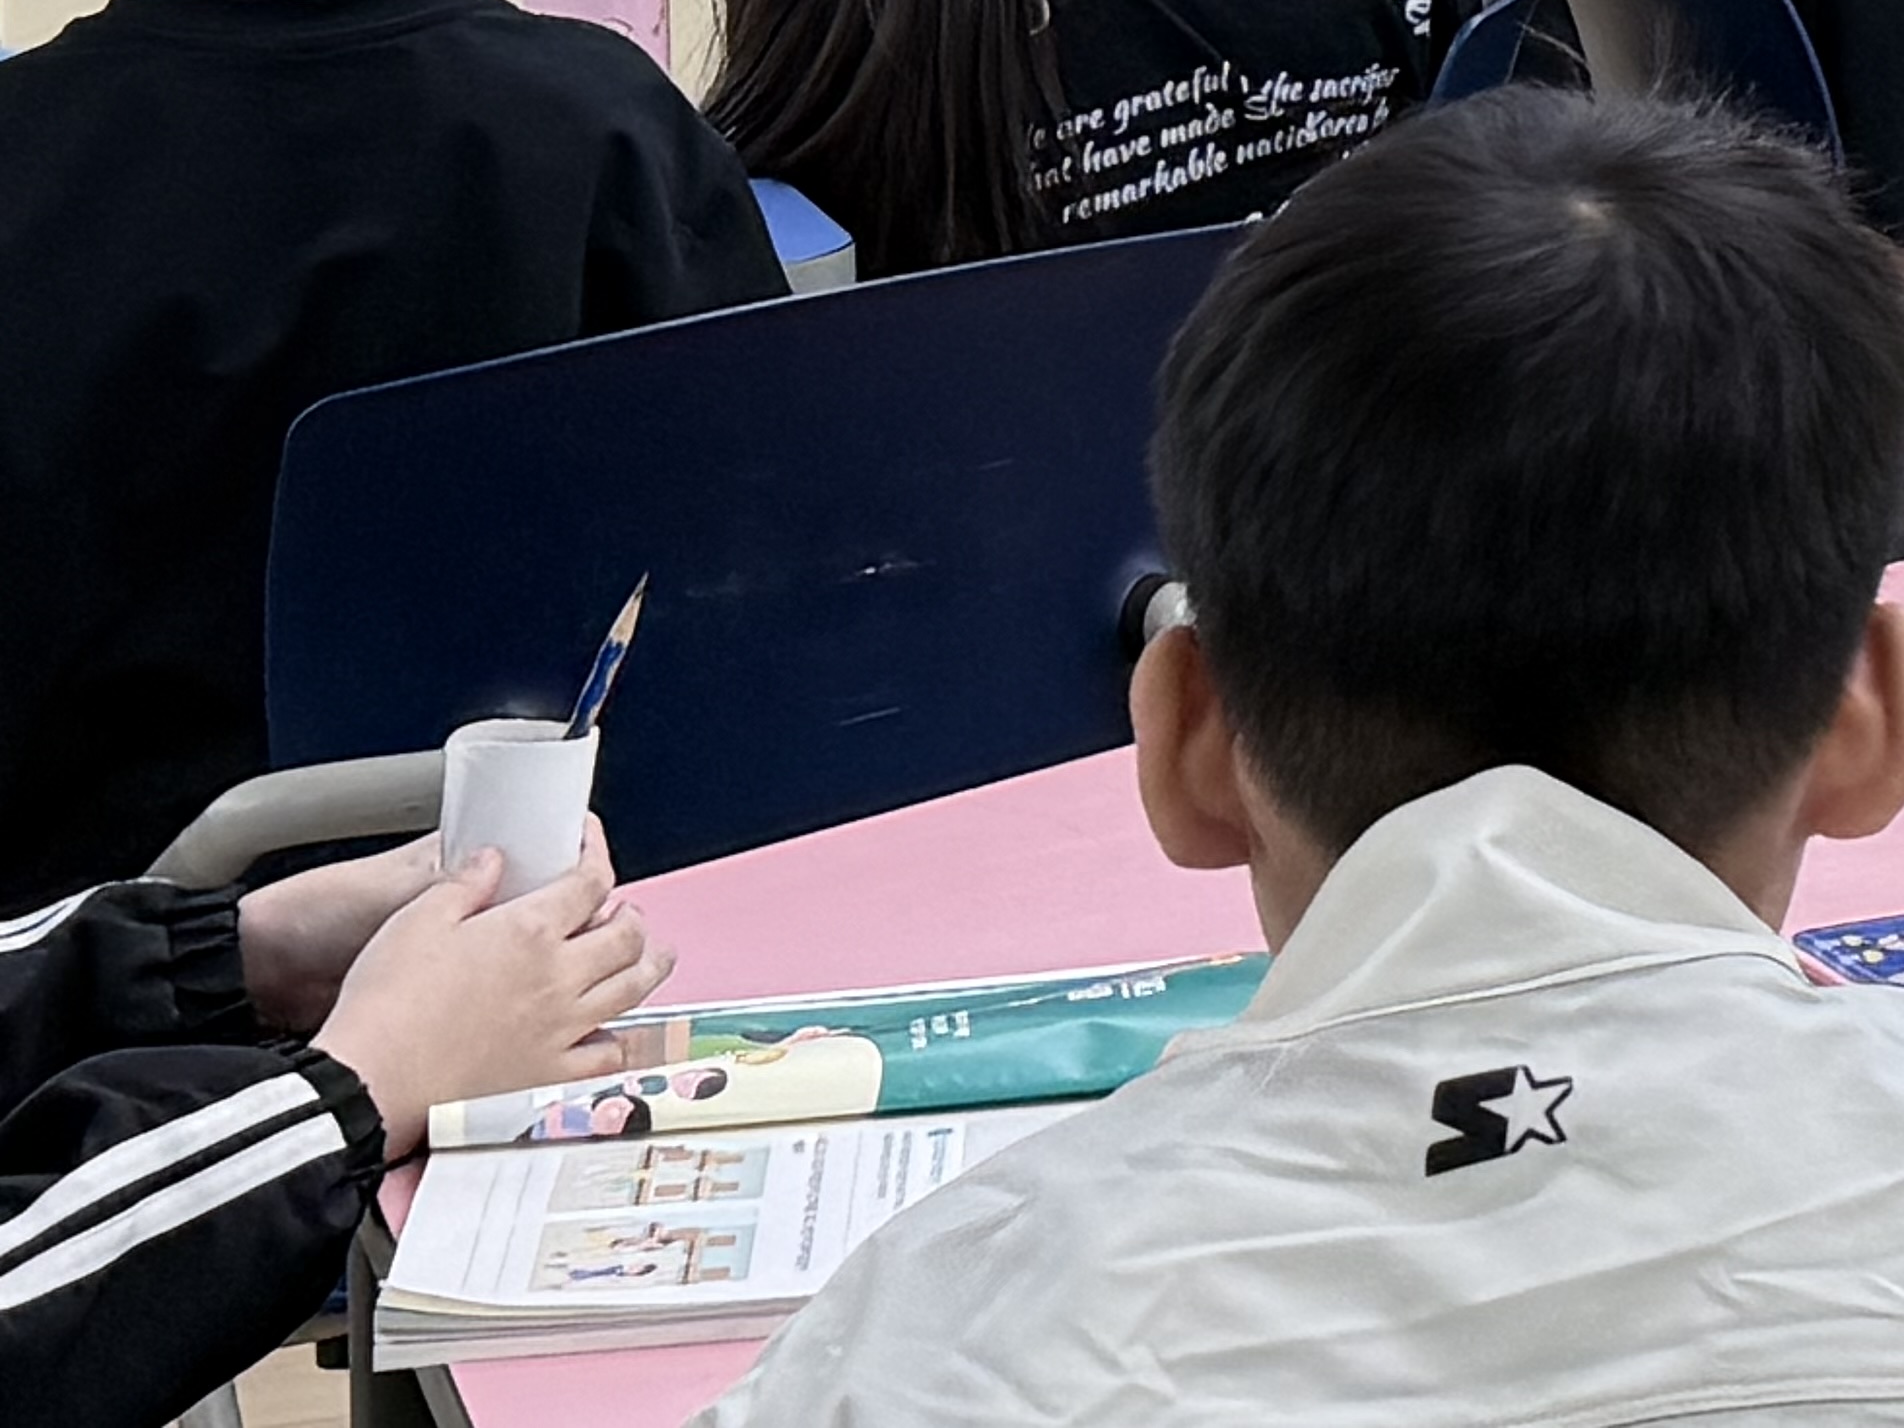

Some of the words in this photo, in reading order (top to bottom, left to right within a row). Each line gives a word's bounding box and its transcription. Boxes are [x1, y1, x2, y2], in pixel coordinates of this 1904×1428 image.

[1055, 108, 1105, 141] are
[1113, 60, 1231, 136] grateful
[1083, 140, 1152, 173] have
[1160, 101, 1235, 149] made
[1062, 141, 1229, 224] remarkable
